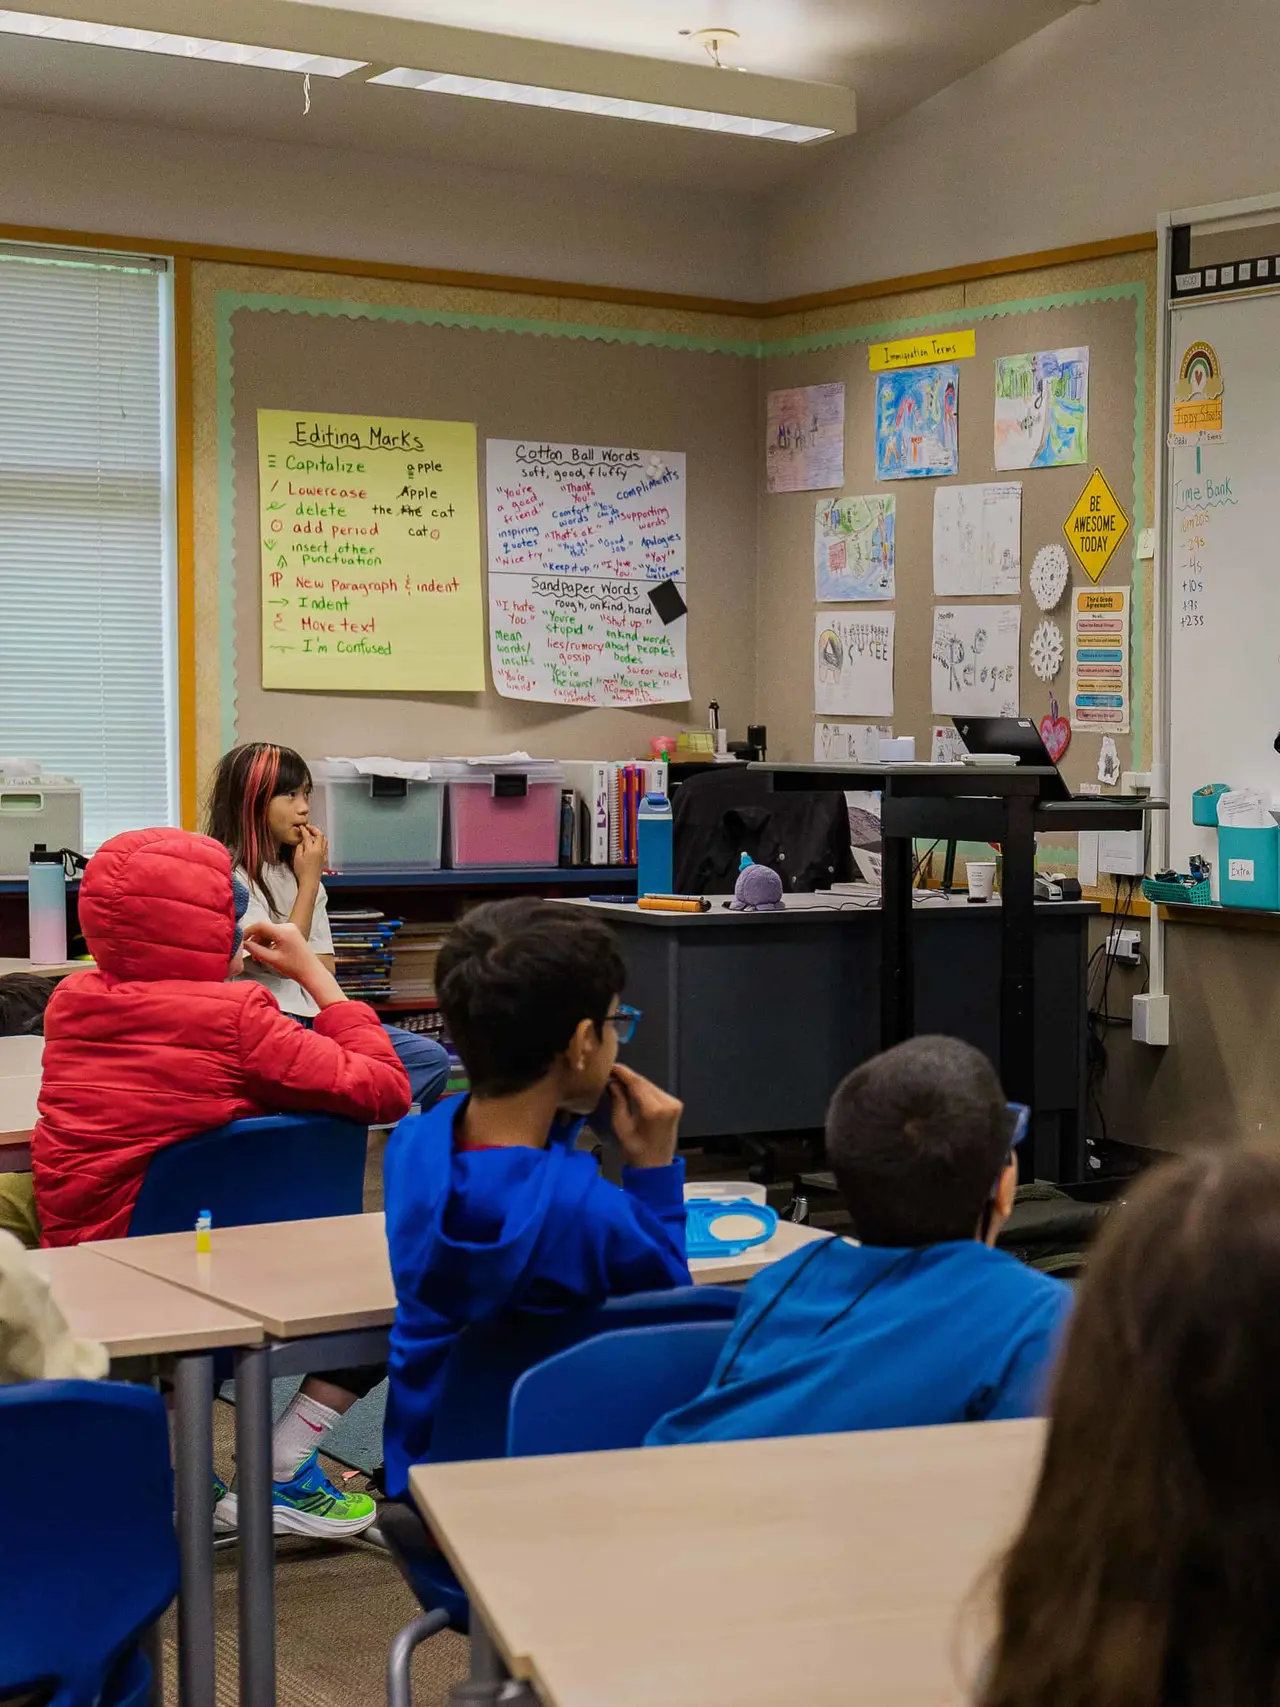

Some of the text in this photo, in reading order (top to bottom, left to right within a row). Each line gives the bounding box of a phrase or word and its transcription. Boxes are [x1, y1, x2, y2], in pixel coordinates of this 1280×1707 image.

[884, 340, 956, 364] Immigration Terms
[296, 422, 424, 448] Editing Marks
[516, 444, 640, 462] Cotton Ball Words
[286, 455, 365, 473] Capitalize
[408, 461, 443, 474] apple
[289, 482, 367, 499] Lowercase
[1206, 476, 1232, 499] Bank
[296, 503, 347, 517] delete
[372, 505, 392, 515] the
[431, 506, 455, 517] cat
[1090, 495, 1101, 512] BE
[292, 520, 379, 540] add period
[408, 526, 428, 537] cat
[1074, 514, 1116, 533] AWESOME
[292, 541, 374, 554] insert other
[1080, 535, 1108, 553] TODAY
[296, 576, 324, 589] New
[417, 581, 460, 592] indent
[531, 576, 639, 597] Sandpaper Words
[299, 597, 350, 611] Indent
[628, 604, 652, 615] hard
[302, 617, 376, 632] Move text
[302, 637, 392, 655] I'm Confused
[1231, 862, 1250, 876] Extra
